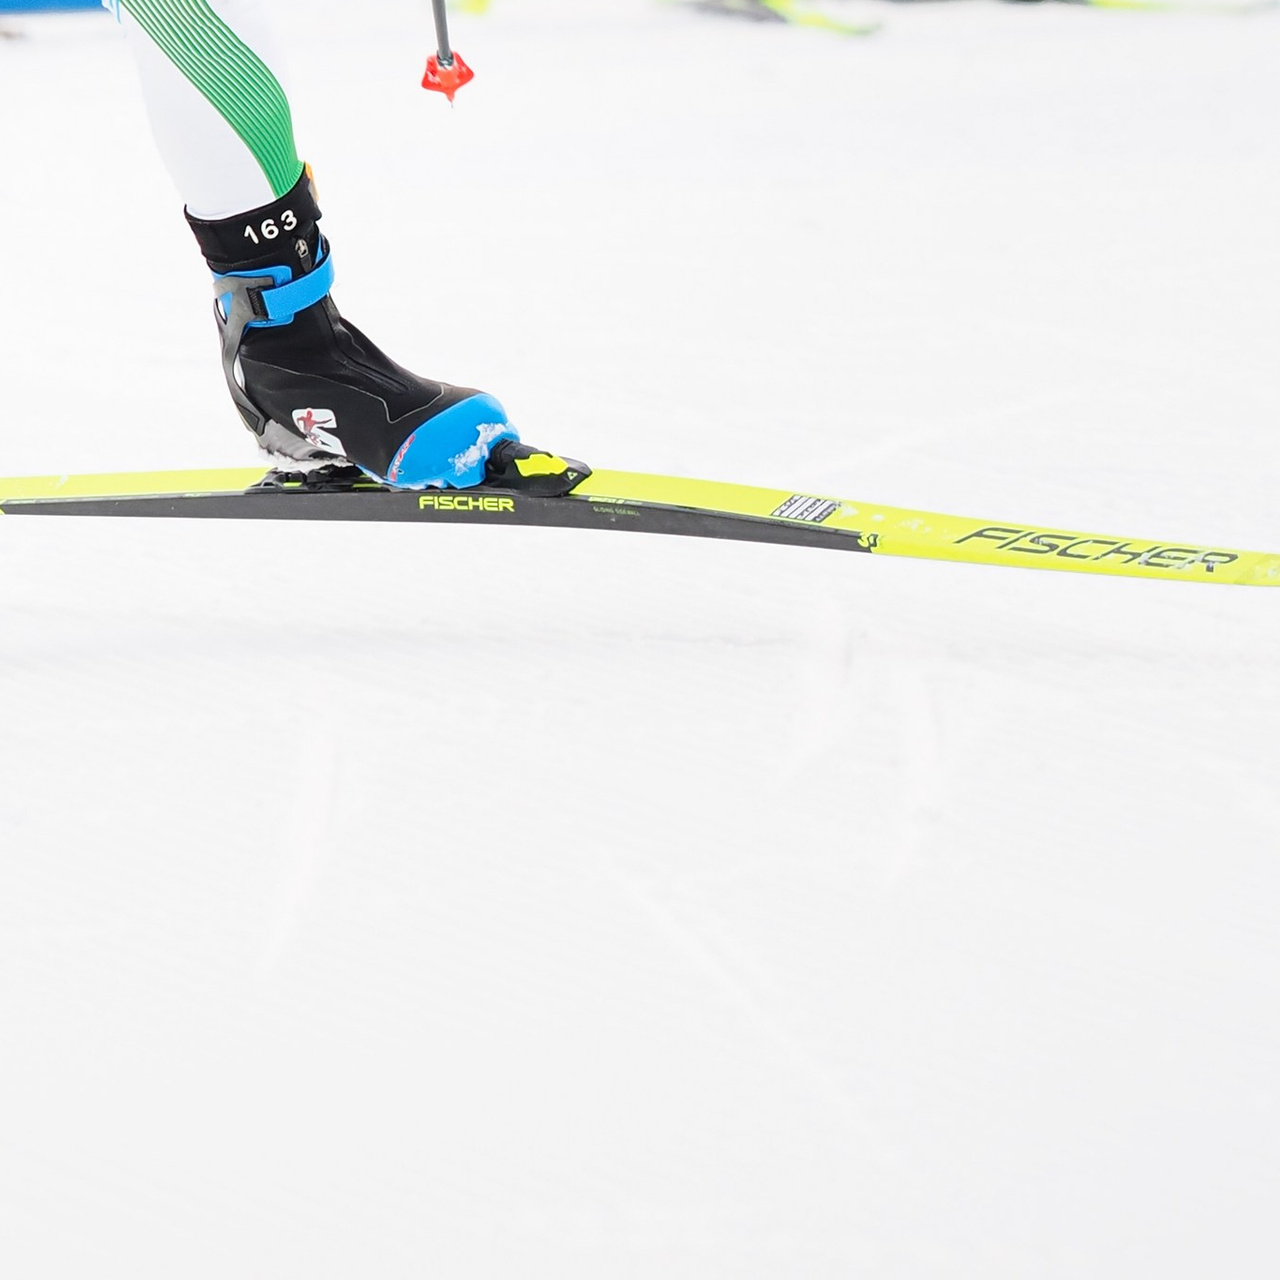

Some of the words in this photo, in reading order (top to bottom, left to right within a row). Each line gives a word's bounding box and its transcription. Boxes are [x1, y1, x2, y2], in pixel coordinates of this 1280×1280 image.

[243, 209, 298, 245] 163
[419, 495, 515, 512] FISCHER
[953, 526, 1239, 573] FISCHER
